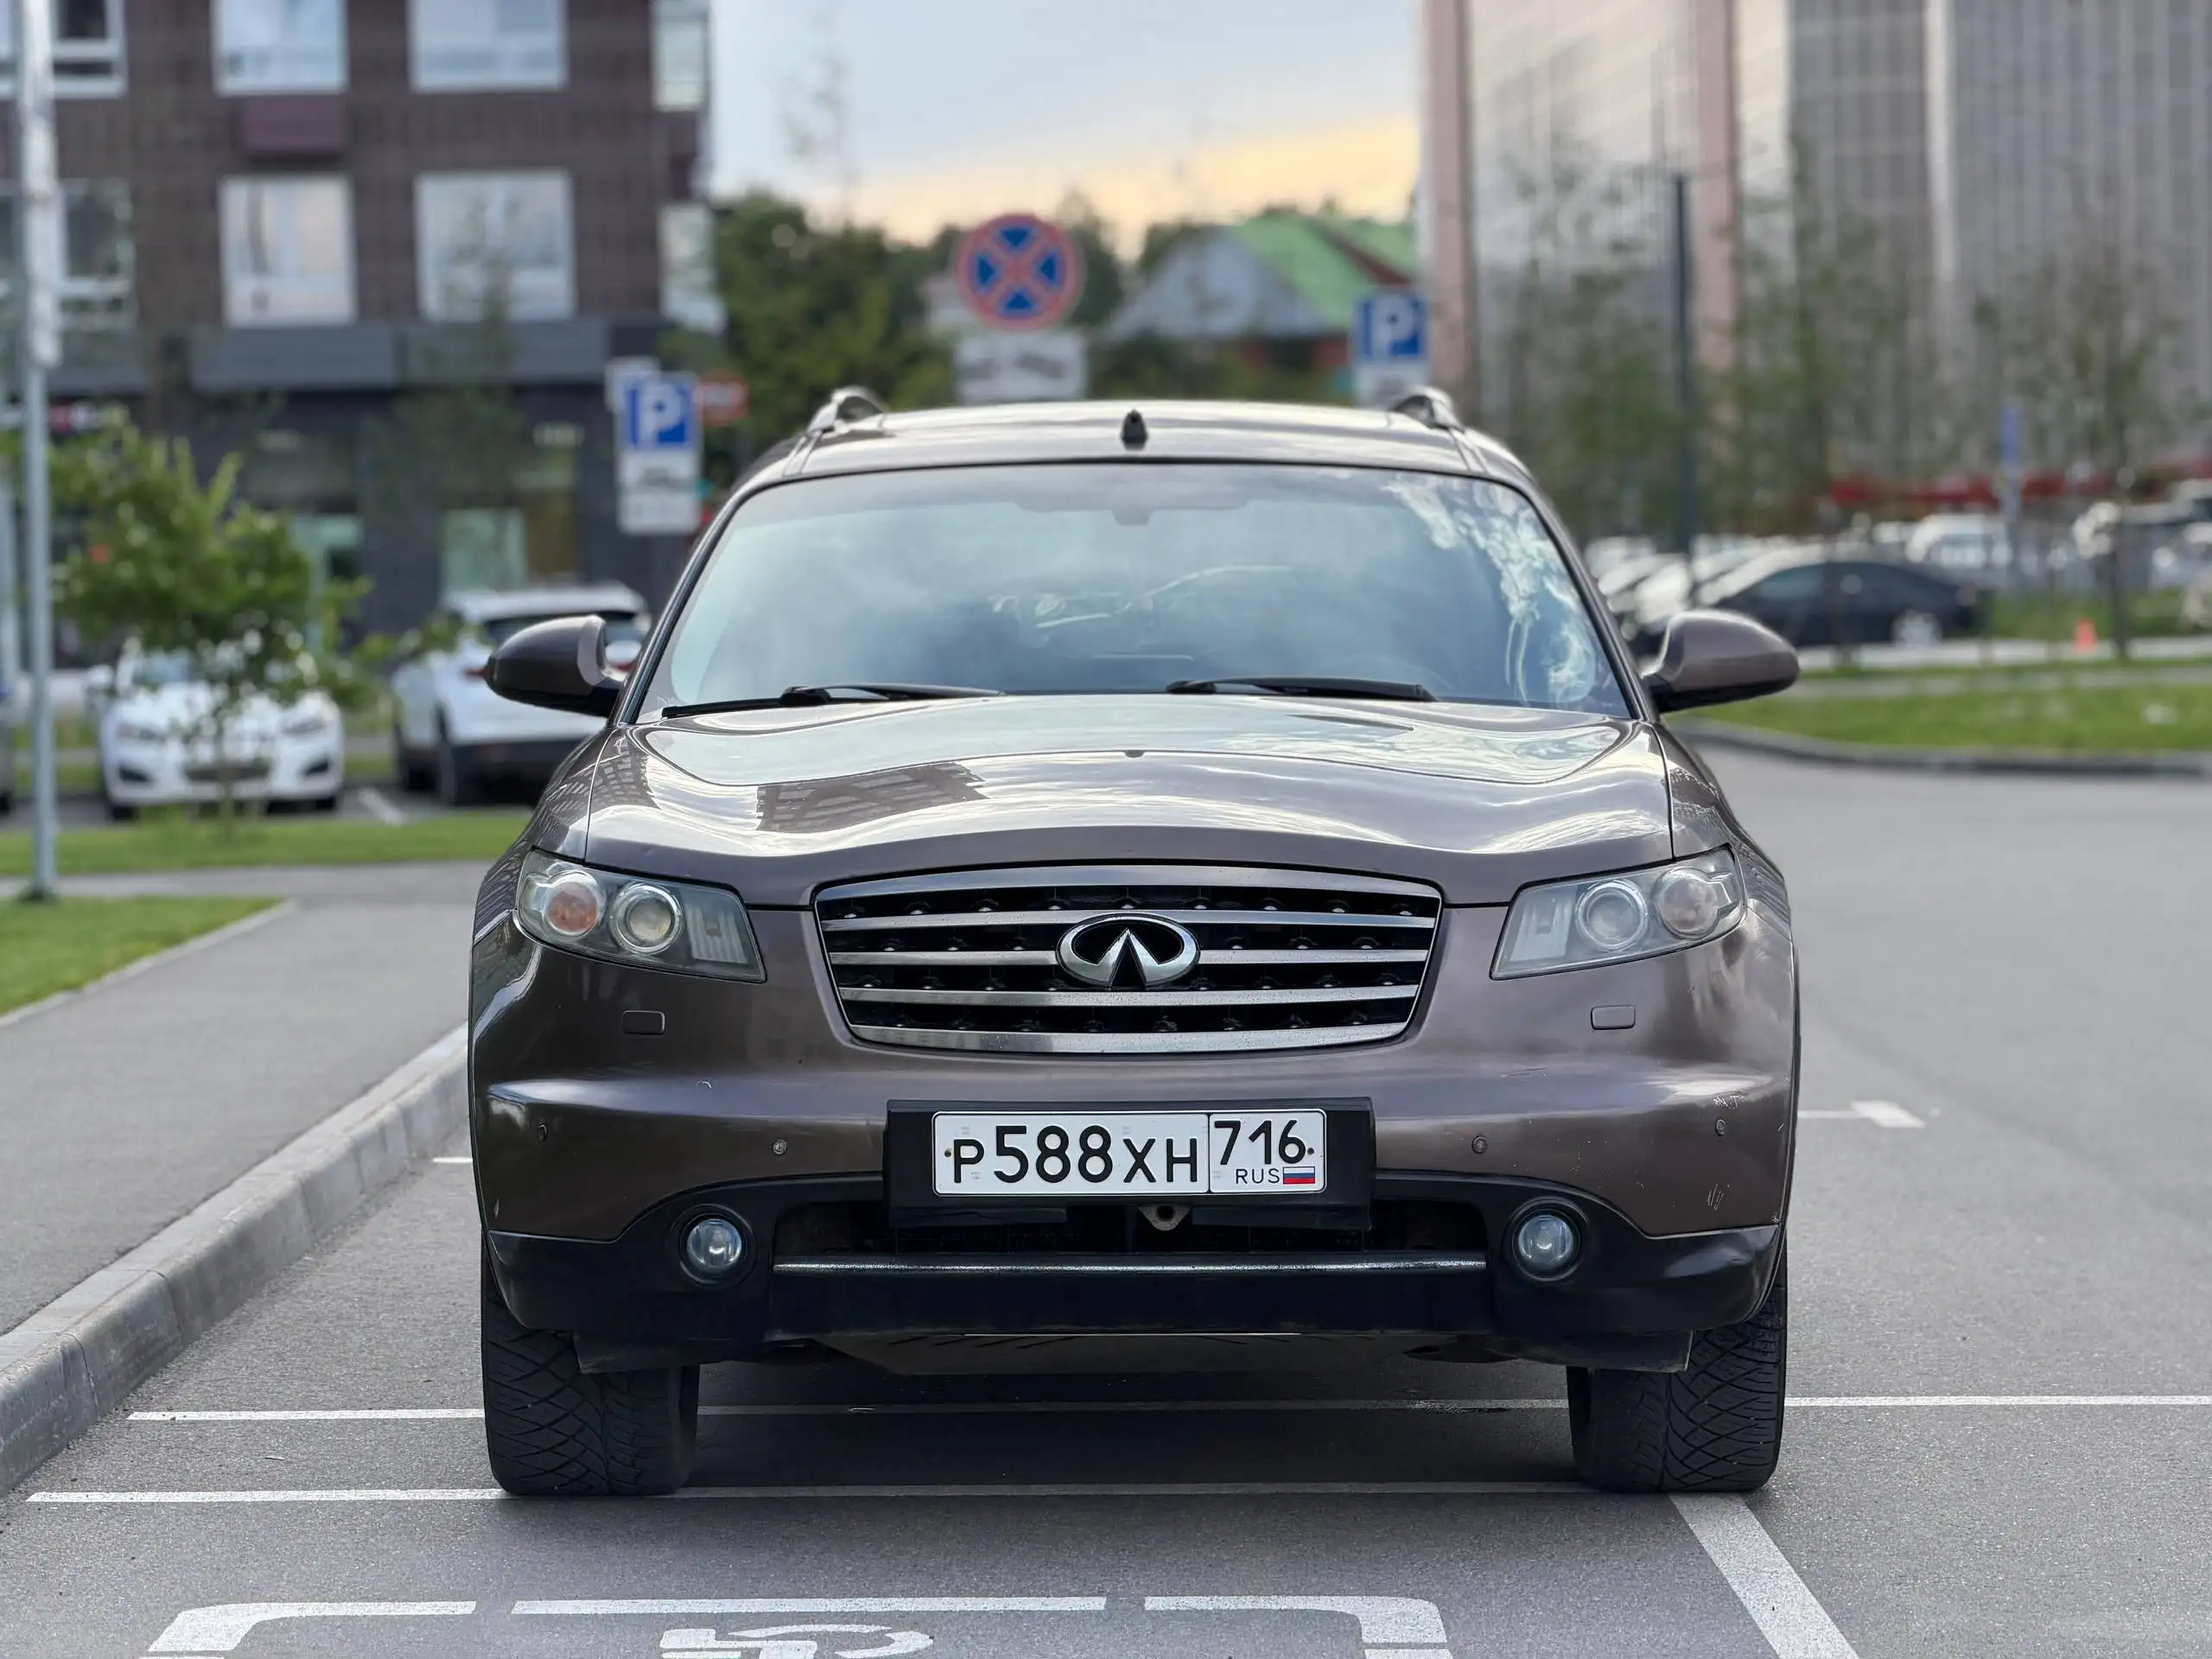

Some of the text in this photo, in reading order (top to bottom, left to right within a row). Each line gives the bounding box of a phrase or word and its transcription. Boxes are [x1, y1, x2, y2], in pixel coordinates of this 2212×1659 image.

[1371, 298, 1413, 357] P
[639, 383, 683, 447] P
[953, 1120, 1306, 1184] Р588ХН 716
[1236, 1168, 1281, 1185] RUS
